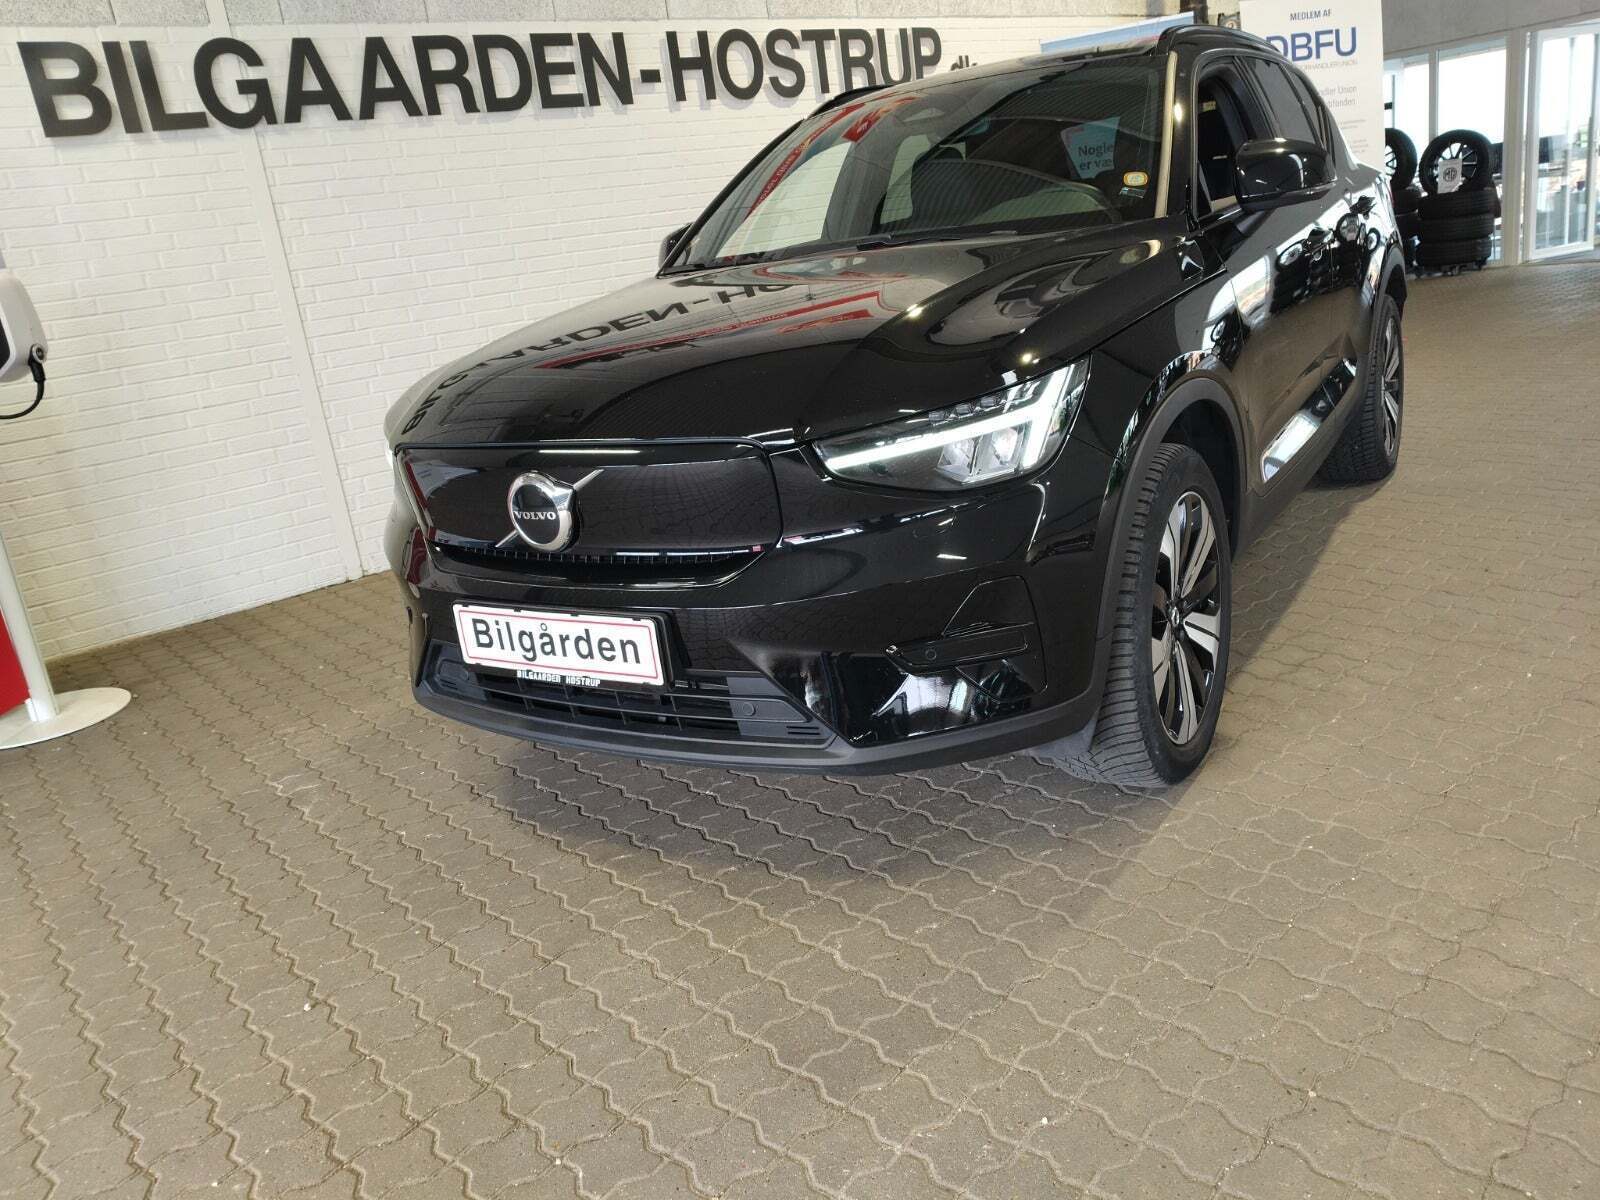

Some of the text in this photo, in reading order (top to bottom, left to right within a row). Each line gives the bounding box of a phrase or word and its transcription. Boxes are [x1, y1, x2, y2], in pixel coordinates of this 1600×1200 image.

[1290, 8, 1333, 21] MEDLEM AF
[1266, 27, 1357, 62] DBFU
[17, 27, 942, 138] BILGAARDEN-HOSTRUP
[1078, 142, 1113, 157] Nogle
[513, 511, 557, 520] VOLVO
[472, 618, 641, 664] Bilgården
[516, 669, 601, 687] BILGAARDEN HOSTRUP
